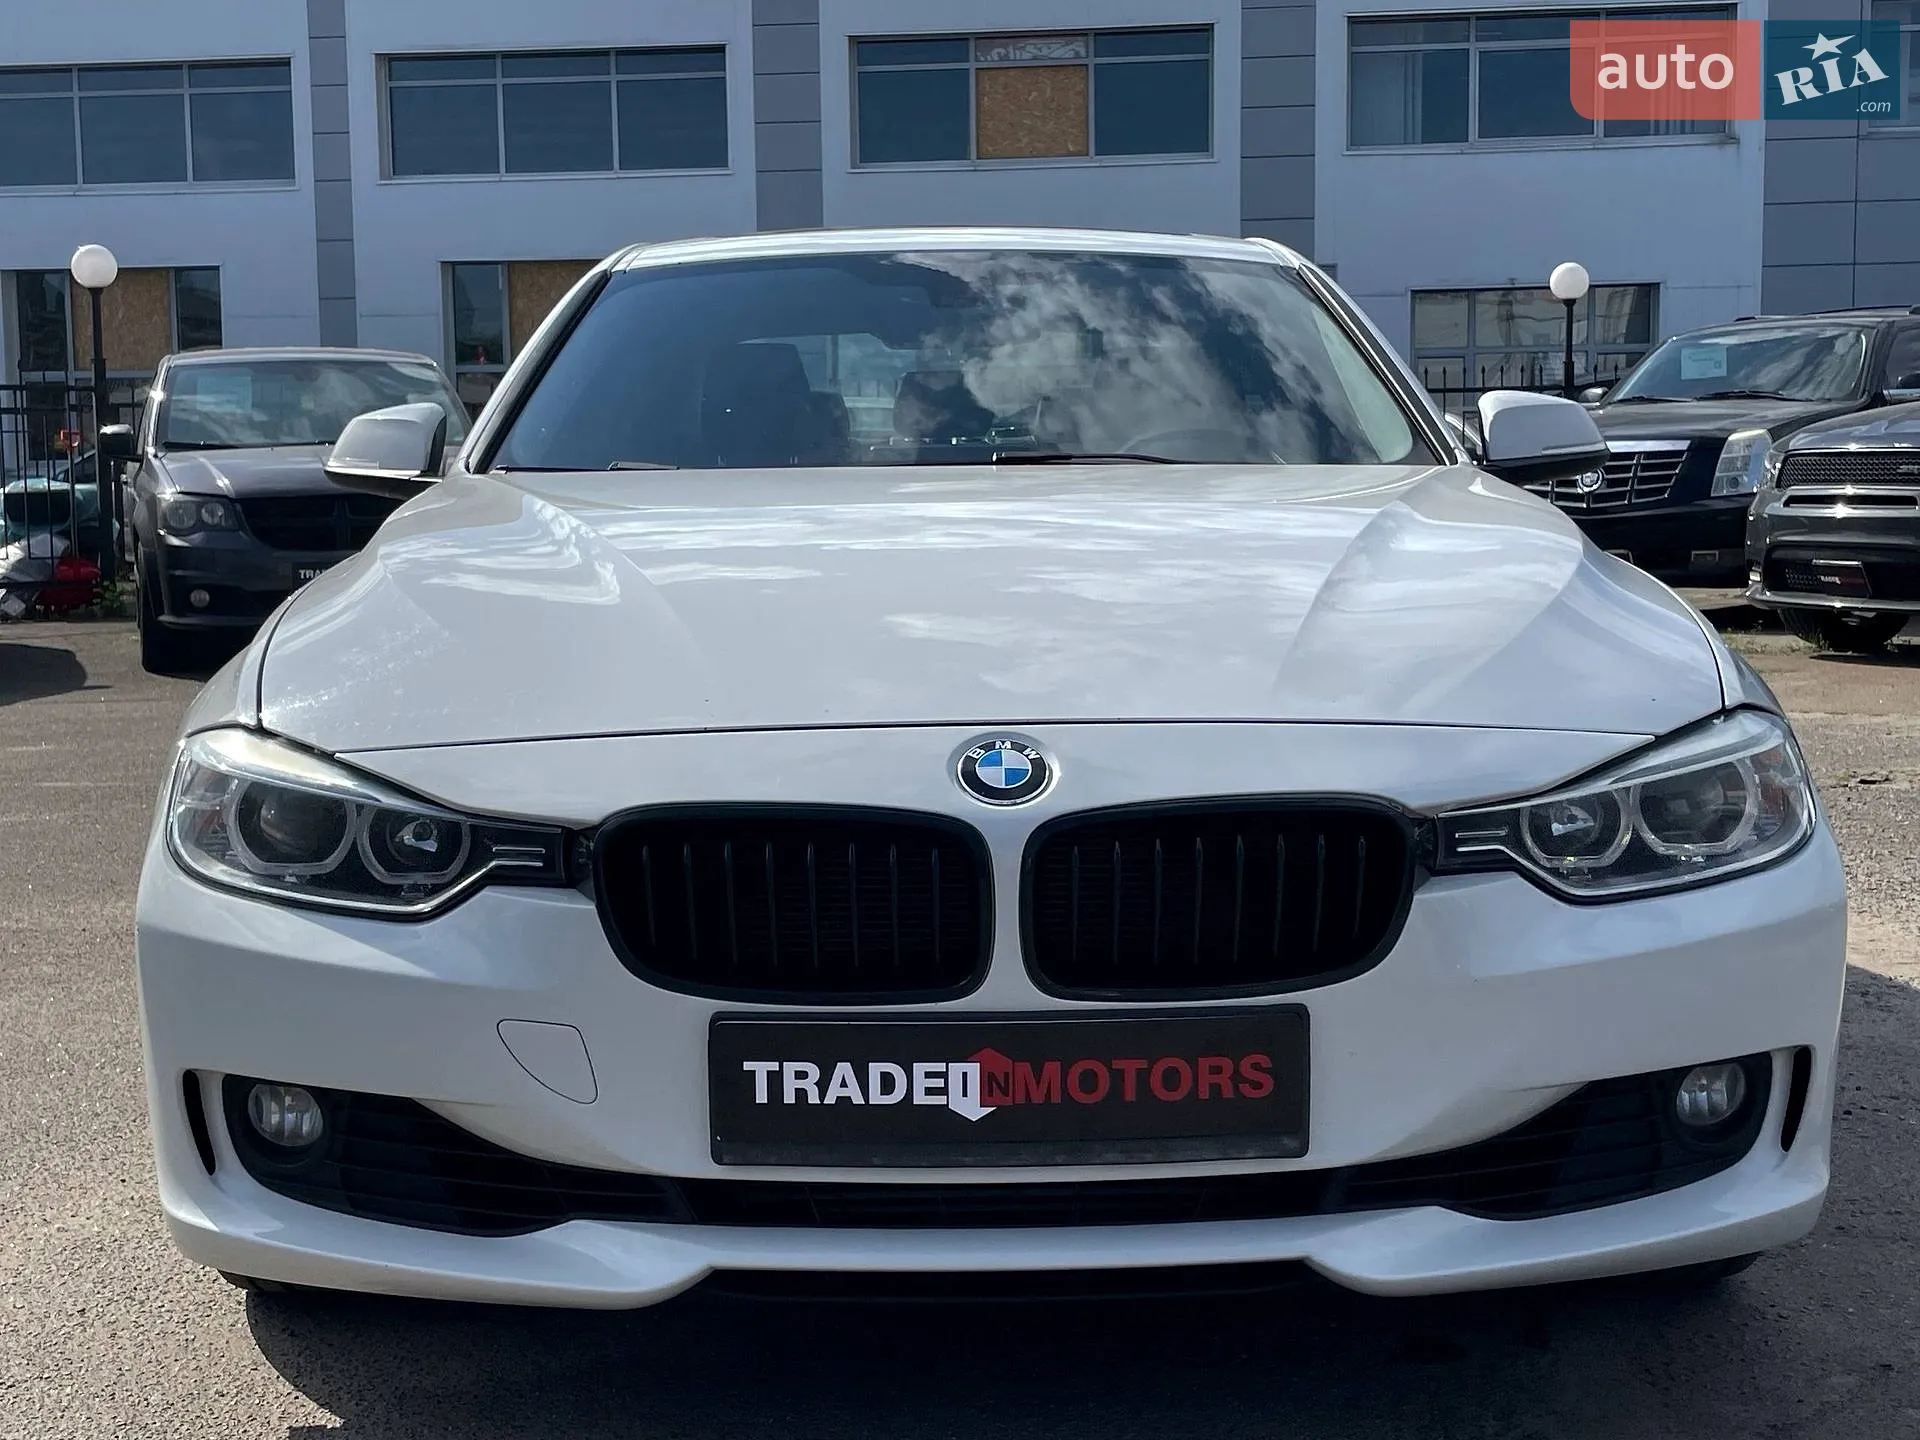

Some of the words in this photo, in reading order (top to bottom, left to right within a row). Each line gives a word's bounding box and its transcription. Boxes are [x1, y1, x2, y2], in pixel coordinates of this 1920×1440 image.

[298, 568, 327, 579] TRA
[967, 740, 1041, 760] BMW
[1014, 1053, 1276, 1105] MOTORS
